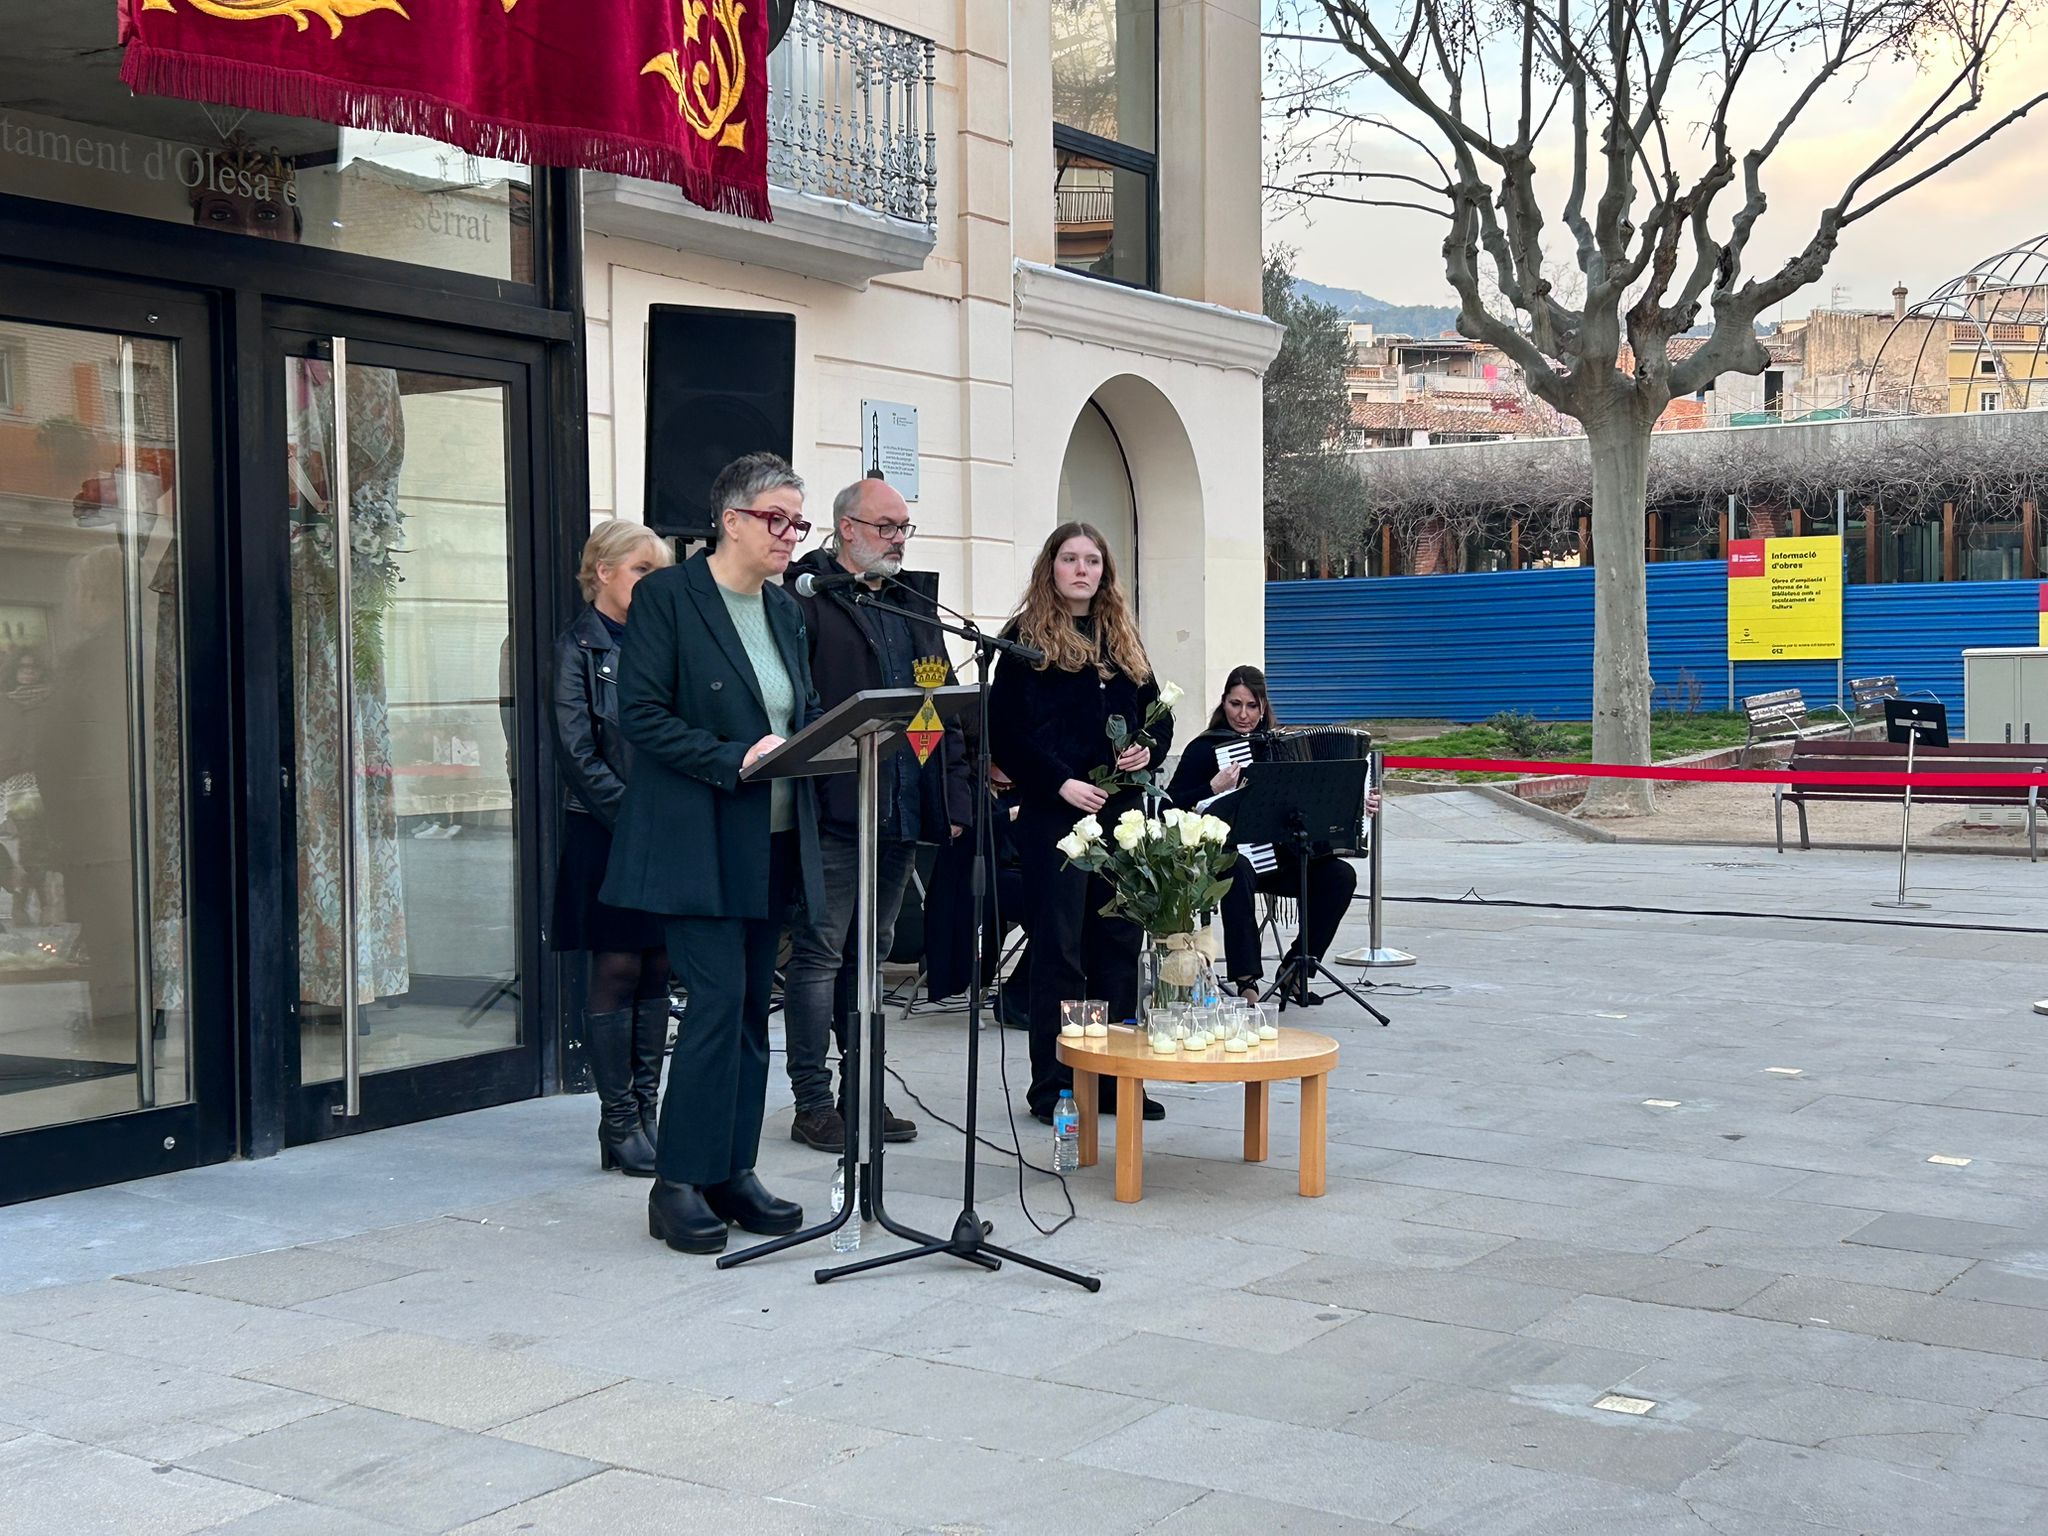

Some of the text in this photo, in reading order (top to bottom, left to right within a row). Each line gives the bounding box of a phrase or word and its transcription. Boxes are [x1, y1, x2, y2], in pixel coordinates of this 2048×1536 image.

[143, 141, 272, 202] d'Olesa
[406, 206, 492, 244] serrat
[1771, 551, 1817, 560] Informació
[1771, 562, 1803, 570] d'obres
